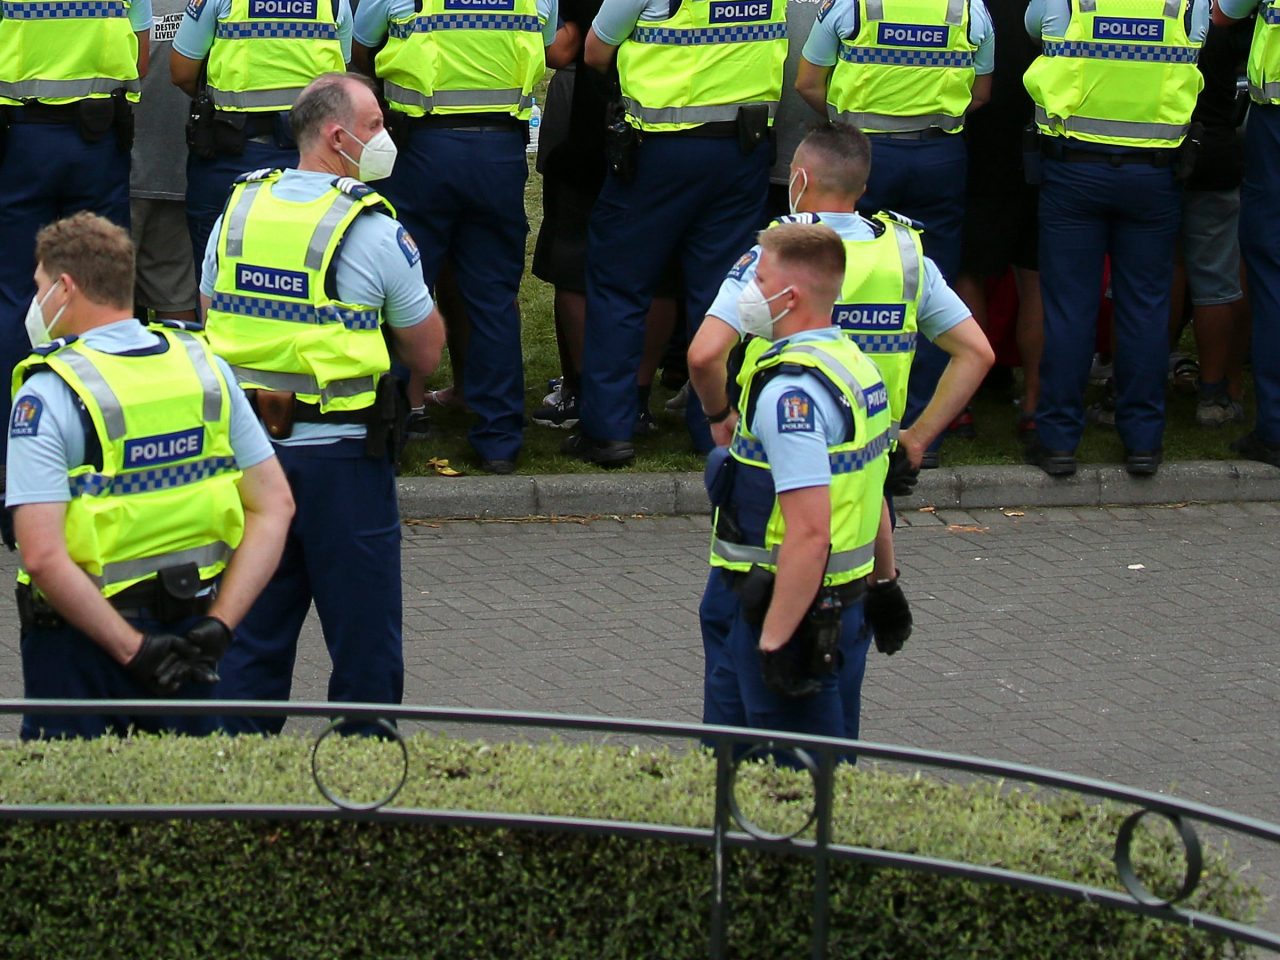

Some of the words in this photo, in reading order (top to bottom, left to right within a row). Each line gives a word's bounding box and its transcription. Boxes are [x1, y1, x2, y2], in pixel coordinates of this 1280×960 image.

[254, 0, 312, 14] POLICE
[714, 3, 768, 18] POLICE
[884, 29, 943, 43] POLICE
[1098, 22, 1159, 36] POLICE
[240, 269, 304, 292] POLICE
[837, 310, 901, 325] POLICE
[782, 422, 809, 430] POLICE
[130, 434, 199, 462] POLICE
